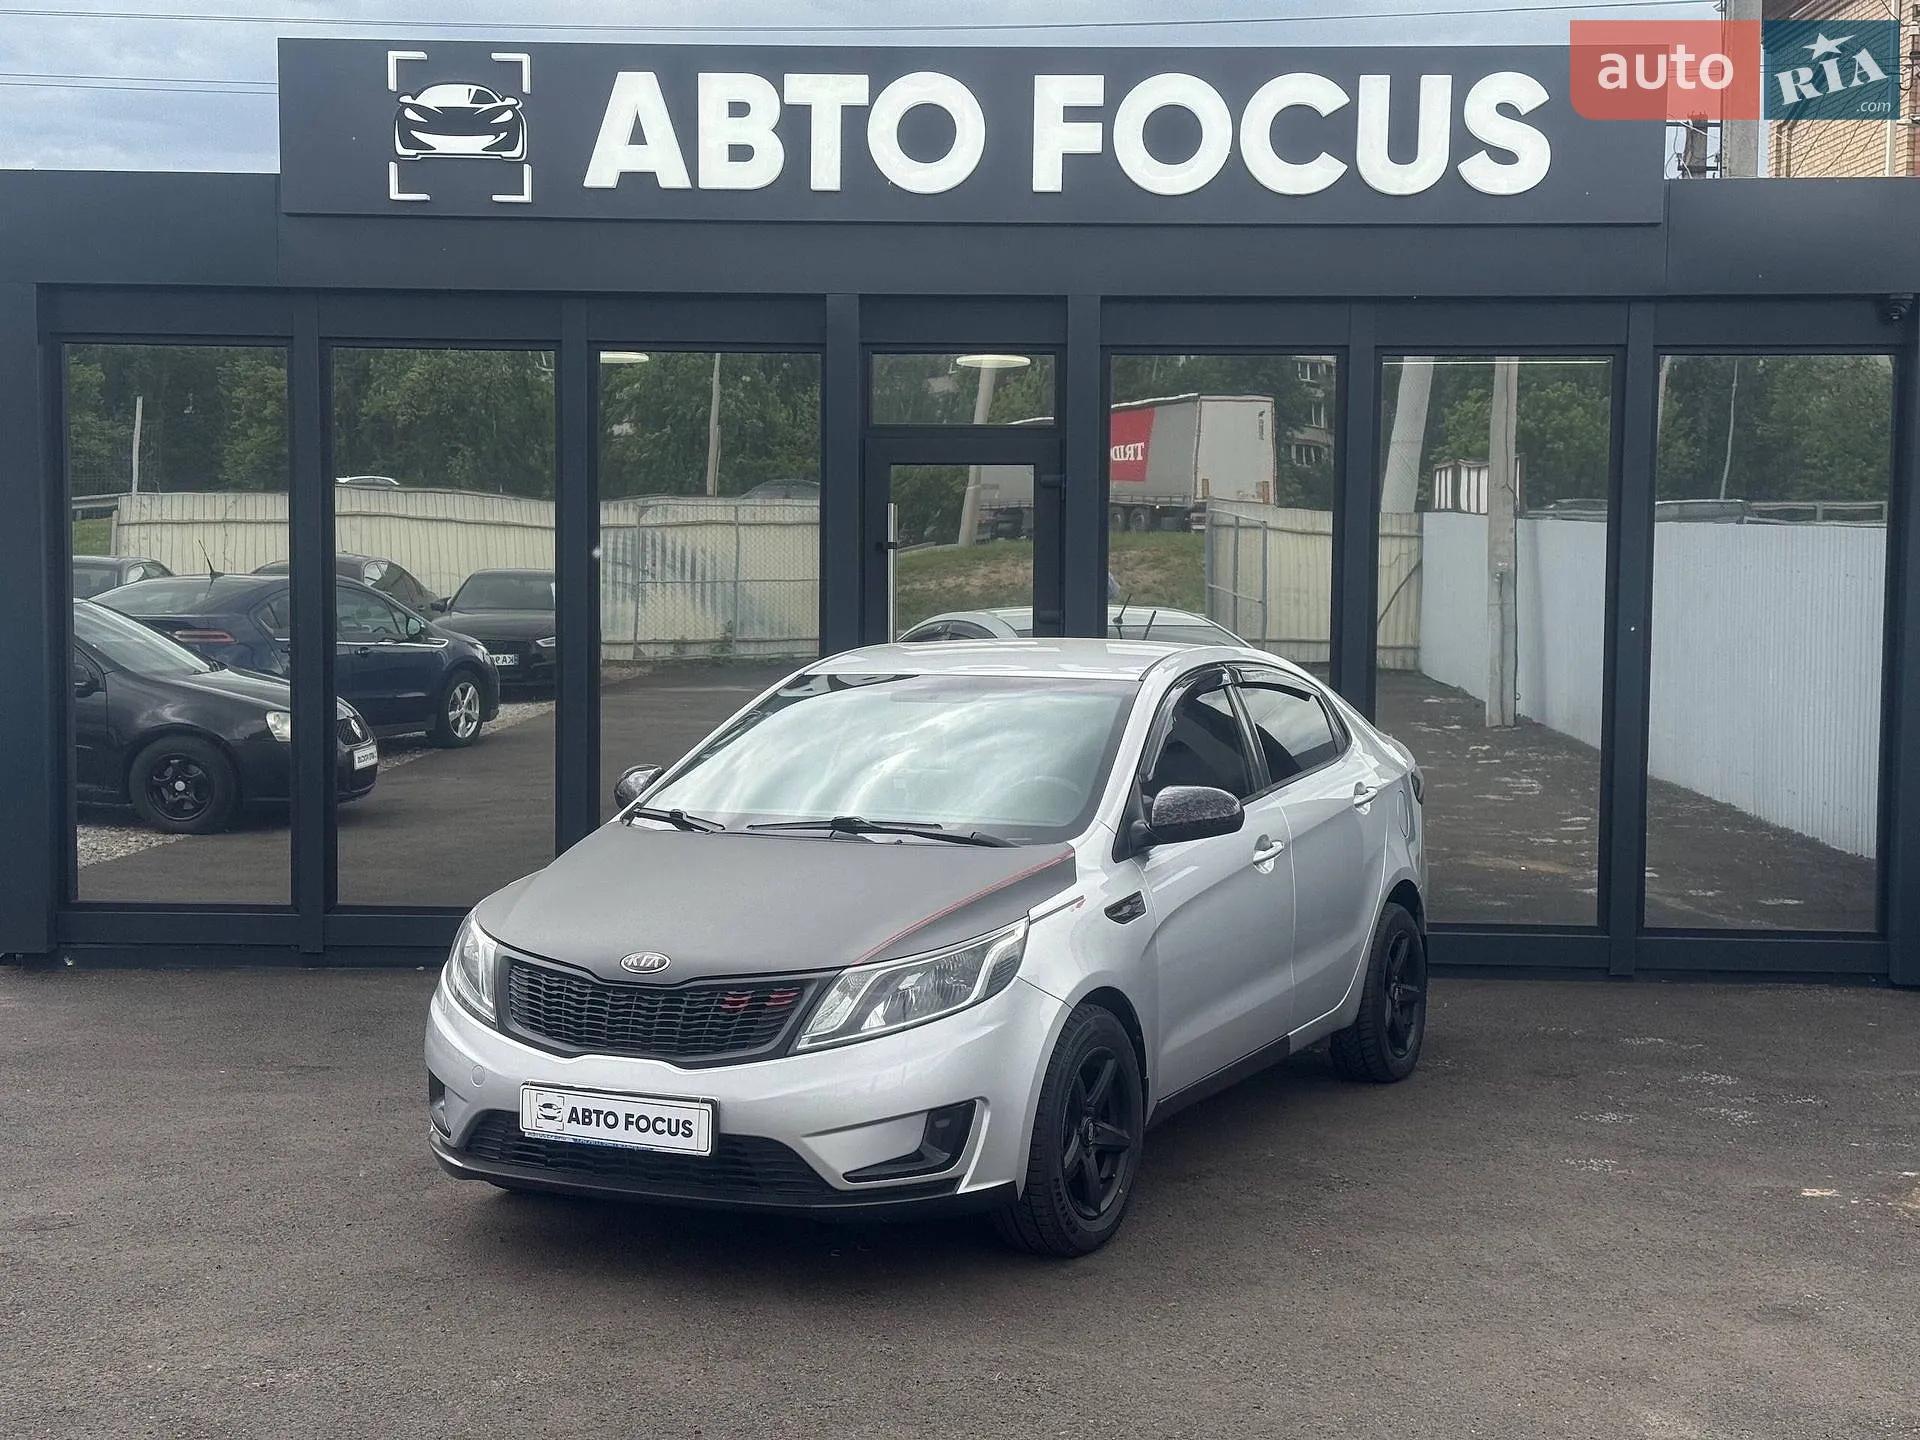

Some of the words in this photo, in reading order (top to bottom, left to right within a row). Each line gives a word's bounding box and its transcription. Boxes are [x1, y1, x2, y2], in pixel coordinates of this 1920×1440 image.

[583, 71, 986, 194] АВТО
[1032, 71, 1551, 195] FOCUS
[567, 1106, 619, 1130] АВТО
[624, 1113, 694, 1138] FOCUS
